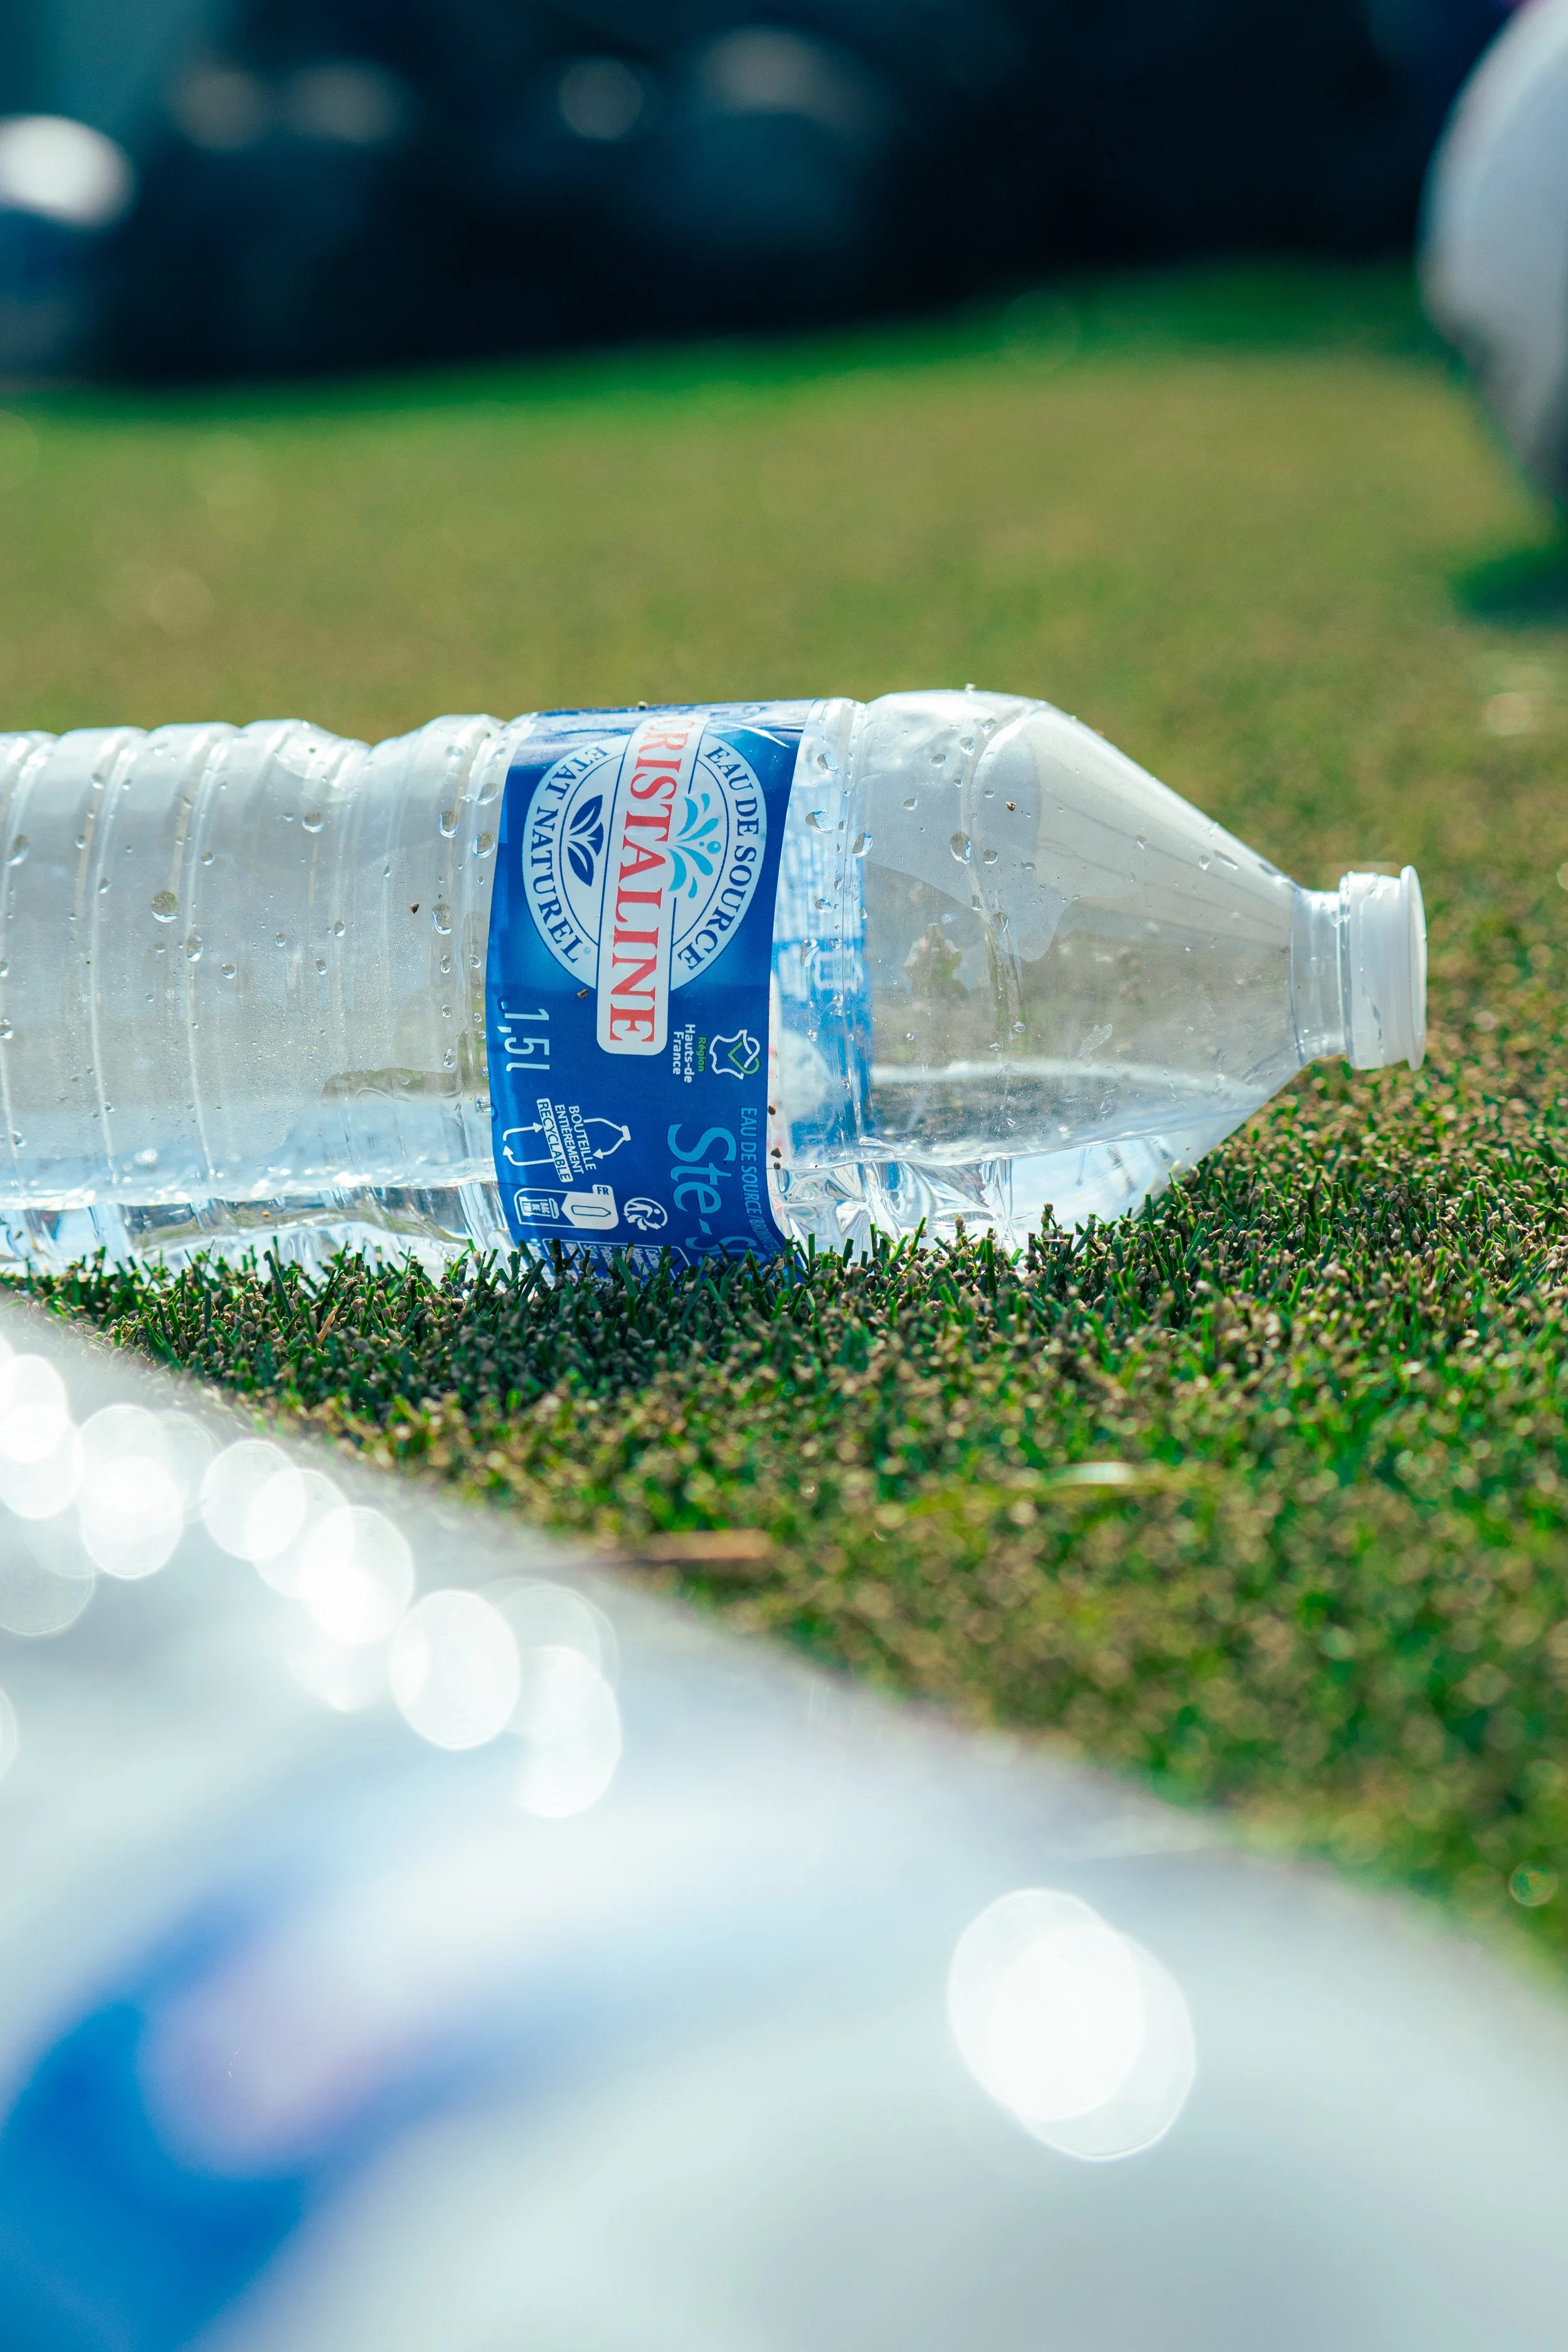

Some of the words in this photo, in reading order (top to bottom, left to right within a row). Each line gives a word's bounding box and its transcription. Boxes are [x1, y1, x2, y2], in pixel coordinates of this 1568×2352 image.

[544, 745, 612, 800] ETAT
[703, 746, 753, 790] EAU
[734, 796, 760, 837] DE
[529, 805, 581, 965] NATUREL
[677, 845, 758, 970] SOURCE
[672, 1031, 685, 1075] France
[683, 1024, 702, 1083] Hauts-de
[696, 1036, 707, 1072] Région
[538, 1102, 569, 1180] RECYCLABLE
[554, 1104, 584, 1173] ENTIÈREMENT
[568, 1106, 596, 1170] BOUTEILLE
[739, 1107, 757, 1137] EAU
[739, 1142, 756, 1162] DE
[596, 1186, 609, 1195] FR
